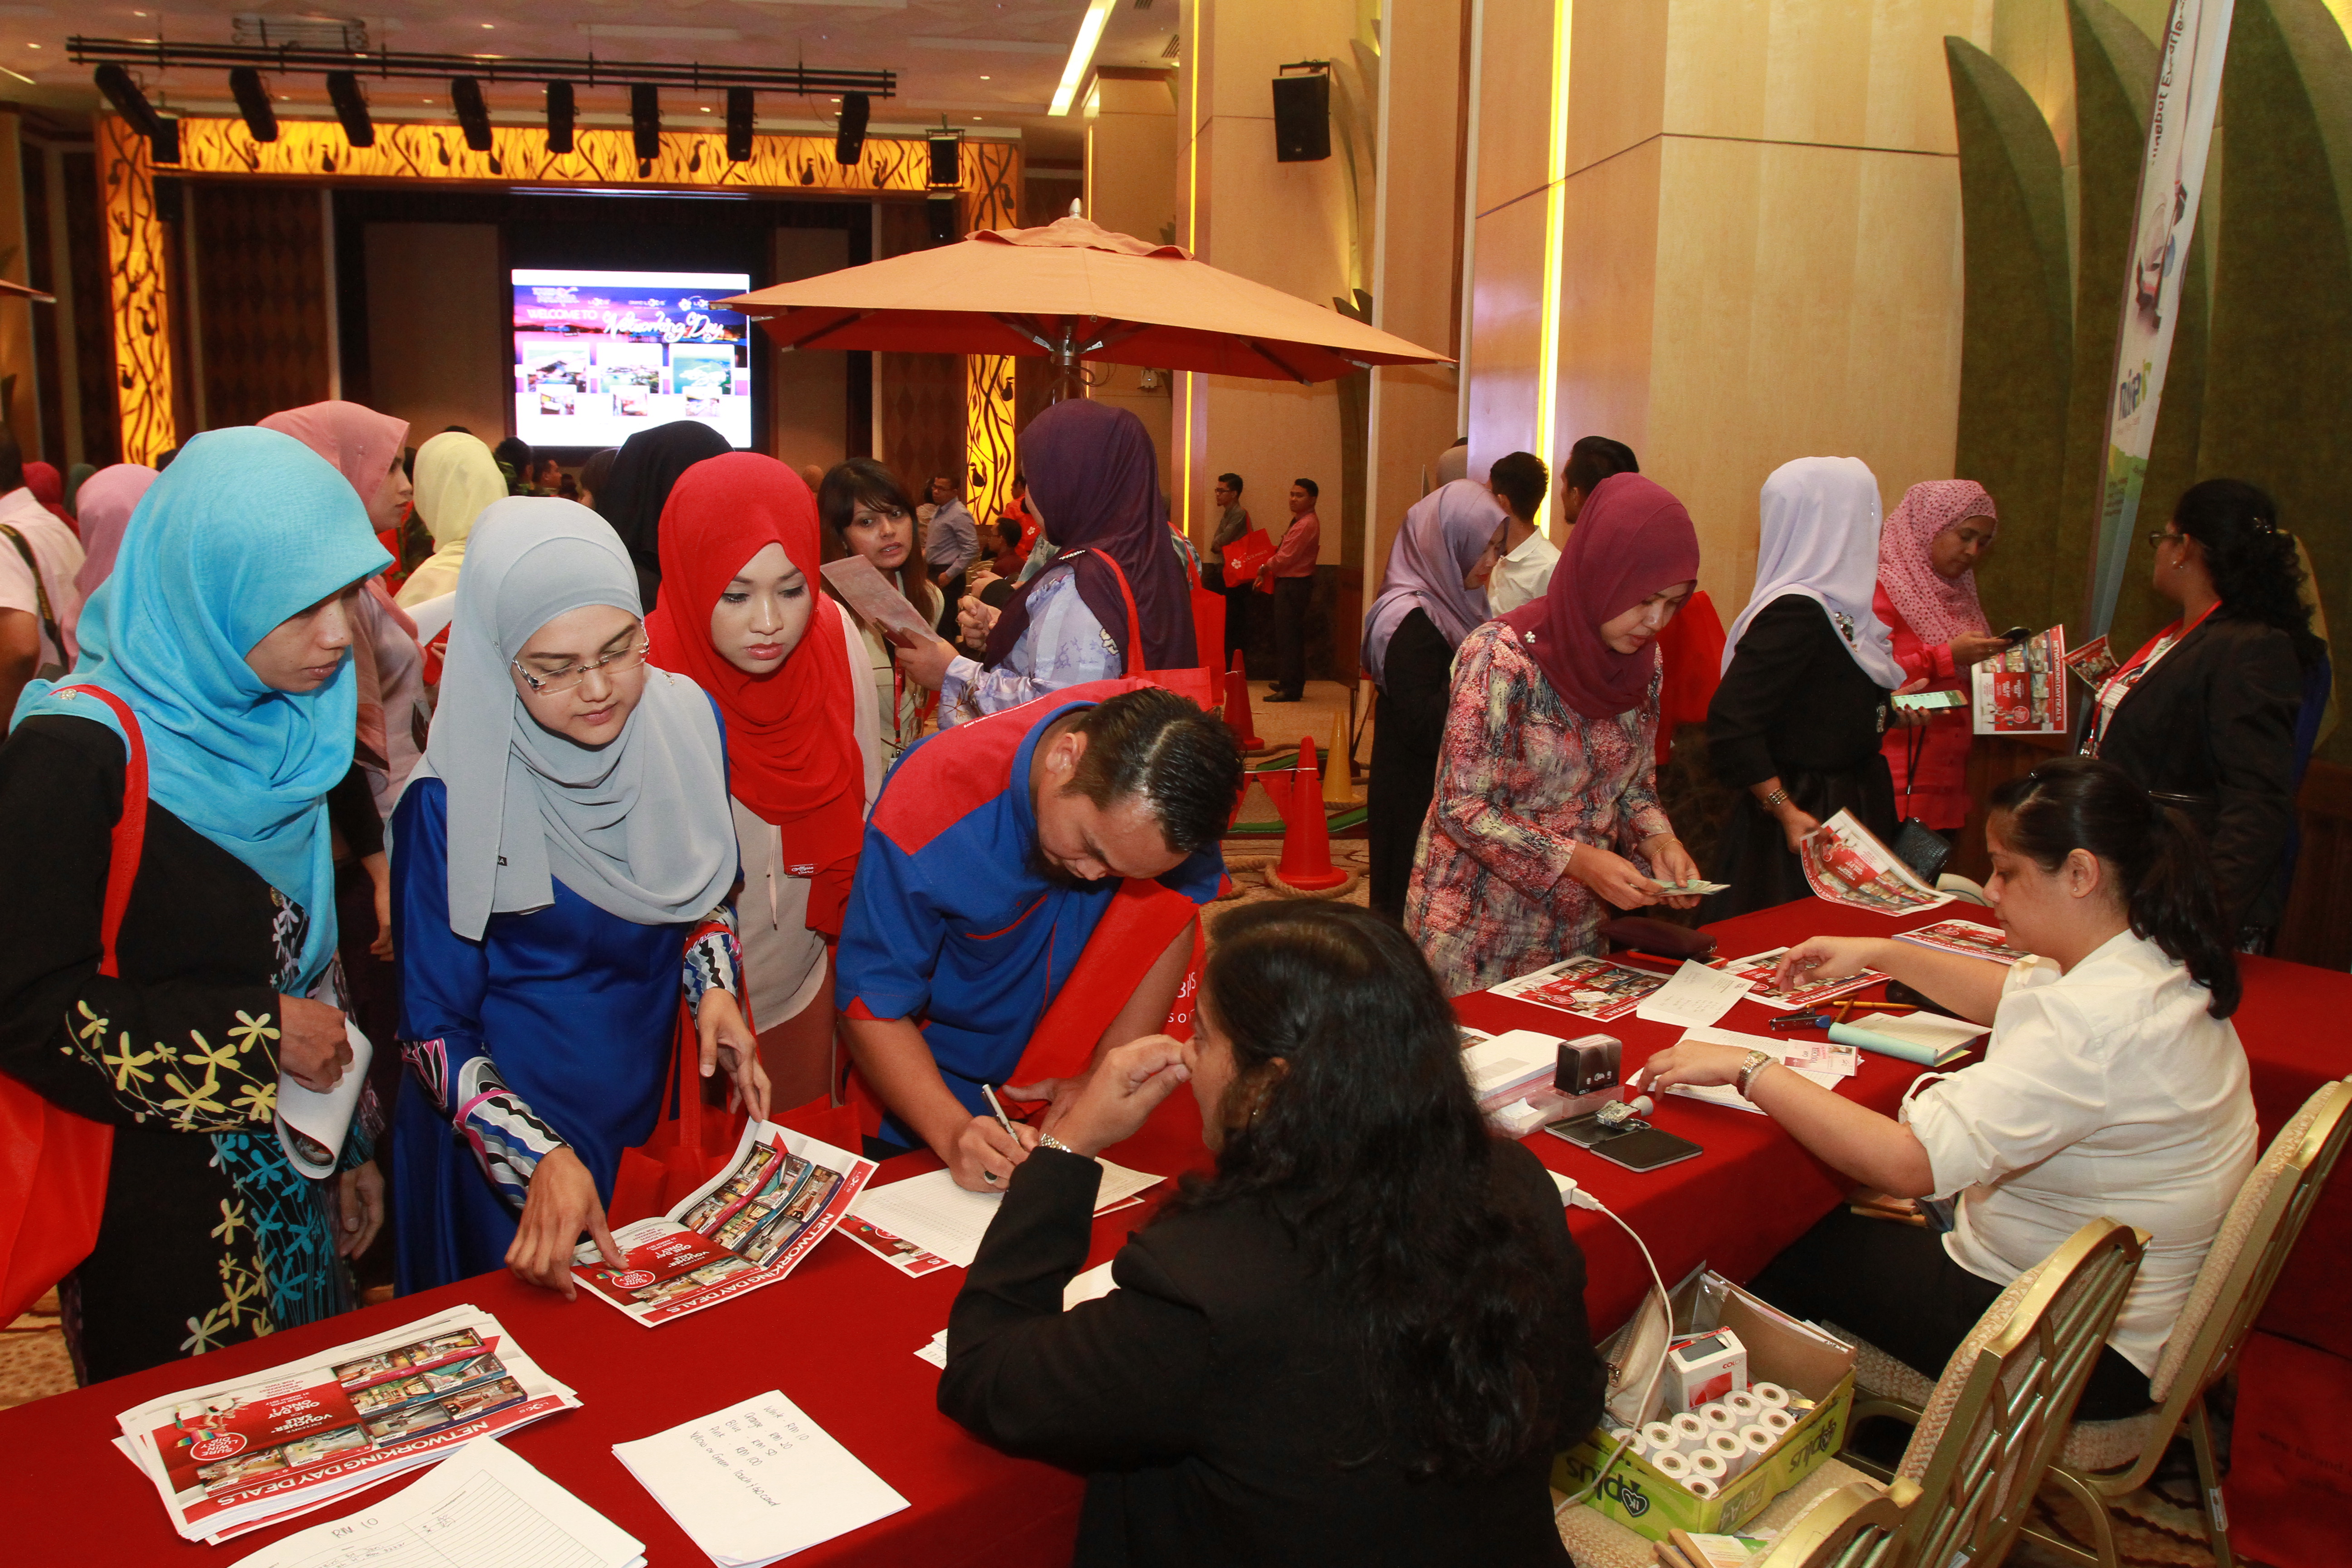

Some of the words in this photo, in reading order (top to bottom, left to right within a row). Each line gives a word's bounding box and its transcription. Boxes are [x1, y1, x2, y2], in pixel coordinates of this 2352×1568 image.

[527, 309, 579, 320] WELCOME
[580, 309, 598, 320] TO
[602, 310, 686, 343] Networking
[686, 311, 725, 343] Day
[660, 1242, 683, 1253] ONLY
[673, 1243, 691, 1253] ONE
[747, 1212, 834, 1283] NETWORKING
[655, 1250, 672, 1259] DAY
[672, 1252, 693, 1261] SALE
[618, 1273, 647, 1281] LUCKY
[720, 1279, 749, 1295] DAY
[665, 1291, 720, 1314] DEALS
[278, 1398, 311, 1411] ONLY
[293, 1401, 320, 1412] ONE
[519, 1401, 549, 1414] LEXIS
[267, 1408, 291, 1419] DAY
[284, 1413, 313, 1424] SALE
[744, 1412, 763, 1428] Orange
[768, 1432, 783, 1441] RM
[784, 1422, 799, 1433] RM
[725, 1419, 741, 1433] Blue
[751, 1439, 766, 1449] RM
[200, 1439, 239, 1449] LUCKY
[343, 1420, 488, 1470] NETWORKING
[709, 1426, 725, 1438] Pink
[735, 1446, 750, 1456] RM
[747, 1456, 763, 1466] 100
[201, 1447, 233, 1456] SURE
[690, 1430, 708, 1448] Yellow
[711, 1453, 729, 1467] Green
[733, 1469, 752, 1484] Touch
[297, 1463, 343, 1485] DAY
[216, 1476, 295, 1506] DEALS
[1743, 1484, 1763, 1510] 70
[330, 1524, 355, 1540] RM
[360, 1515, 380, 1531] 10
